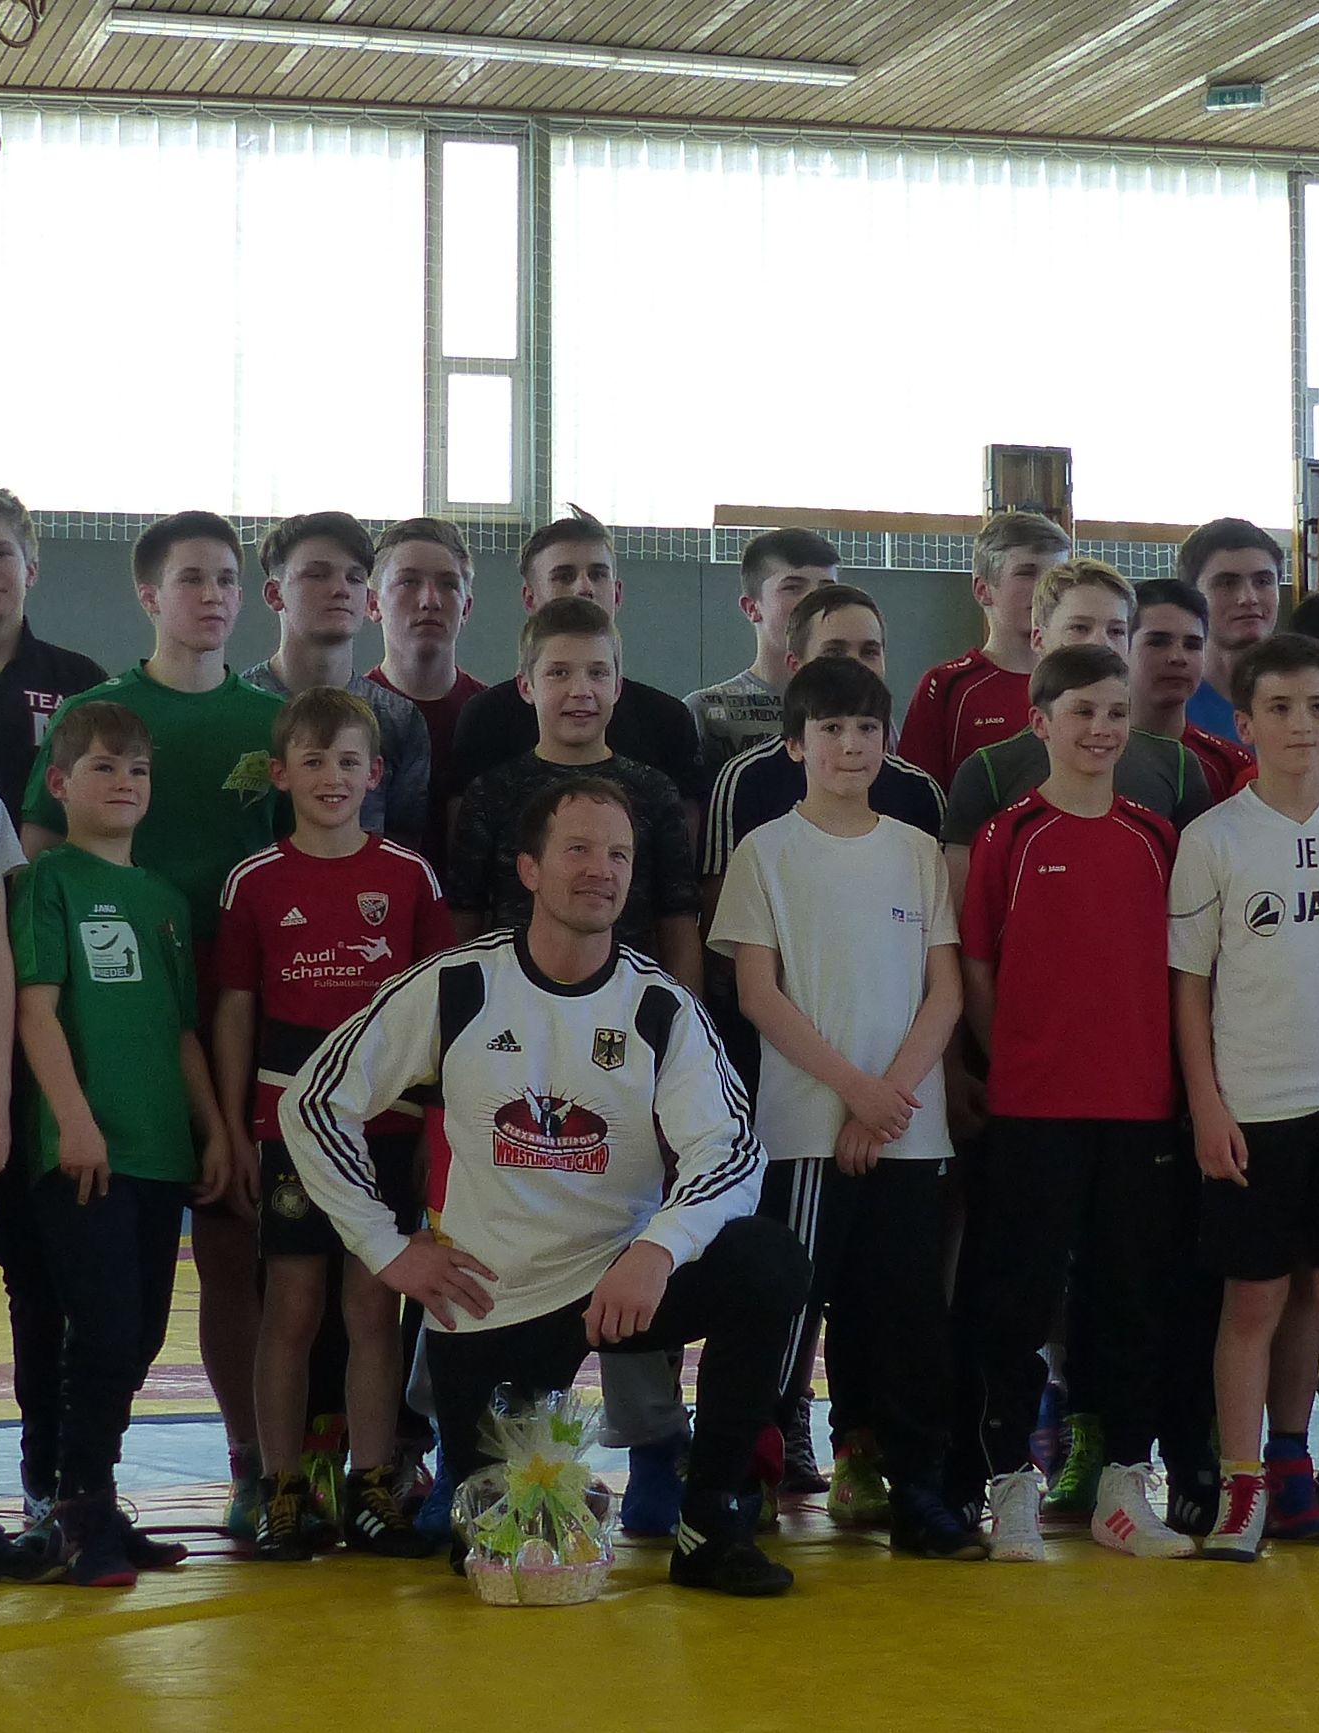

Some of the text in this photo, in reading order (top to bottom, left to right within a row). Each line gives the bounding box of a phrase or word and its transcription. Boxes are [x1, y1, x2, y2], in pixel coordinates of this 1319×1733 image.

[1295, 838, 1318, 869] JE
[293, 948, 336, 965] Audi
[281, 965, 365, 982] Schanzer
[495, 1136, 553, 1167] WRESTLING
[574, 1144, 607, 1173] CAMP
